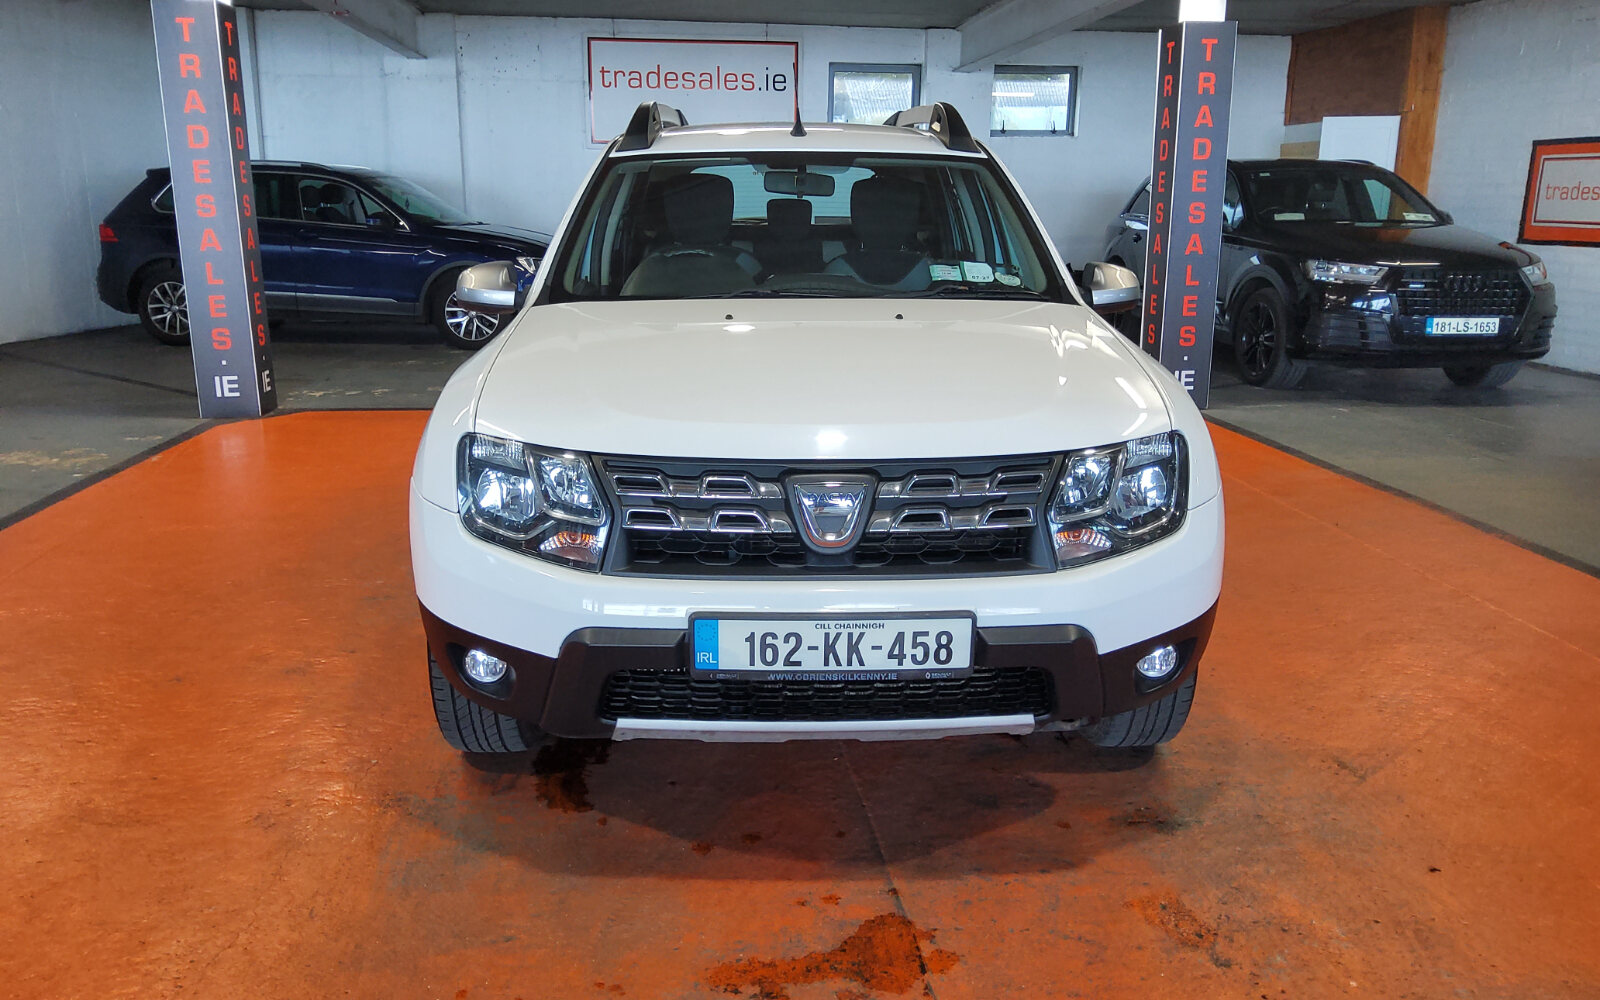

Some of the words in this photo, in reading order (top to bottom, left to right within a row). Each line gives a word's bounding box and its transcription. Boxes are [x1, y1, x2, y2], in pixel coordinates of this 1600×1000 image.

[600, 64, 787, 92] tradesales.ie
[1434, 321, 1497, 333] 181-LS-1653
[834, 622, 885, 630] CHAINNIGH
[744, 630, 954, 667] 162-KK-458
[697, 652, 717, 664] IRL
